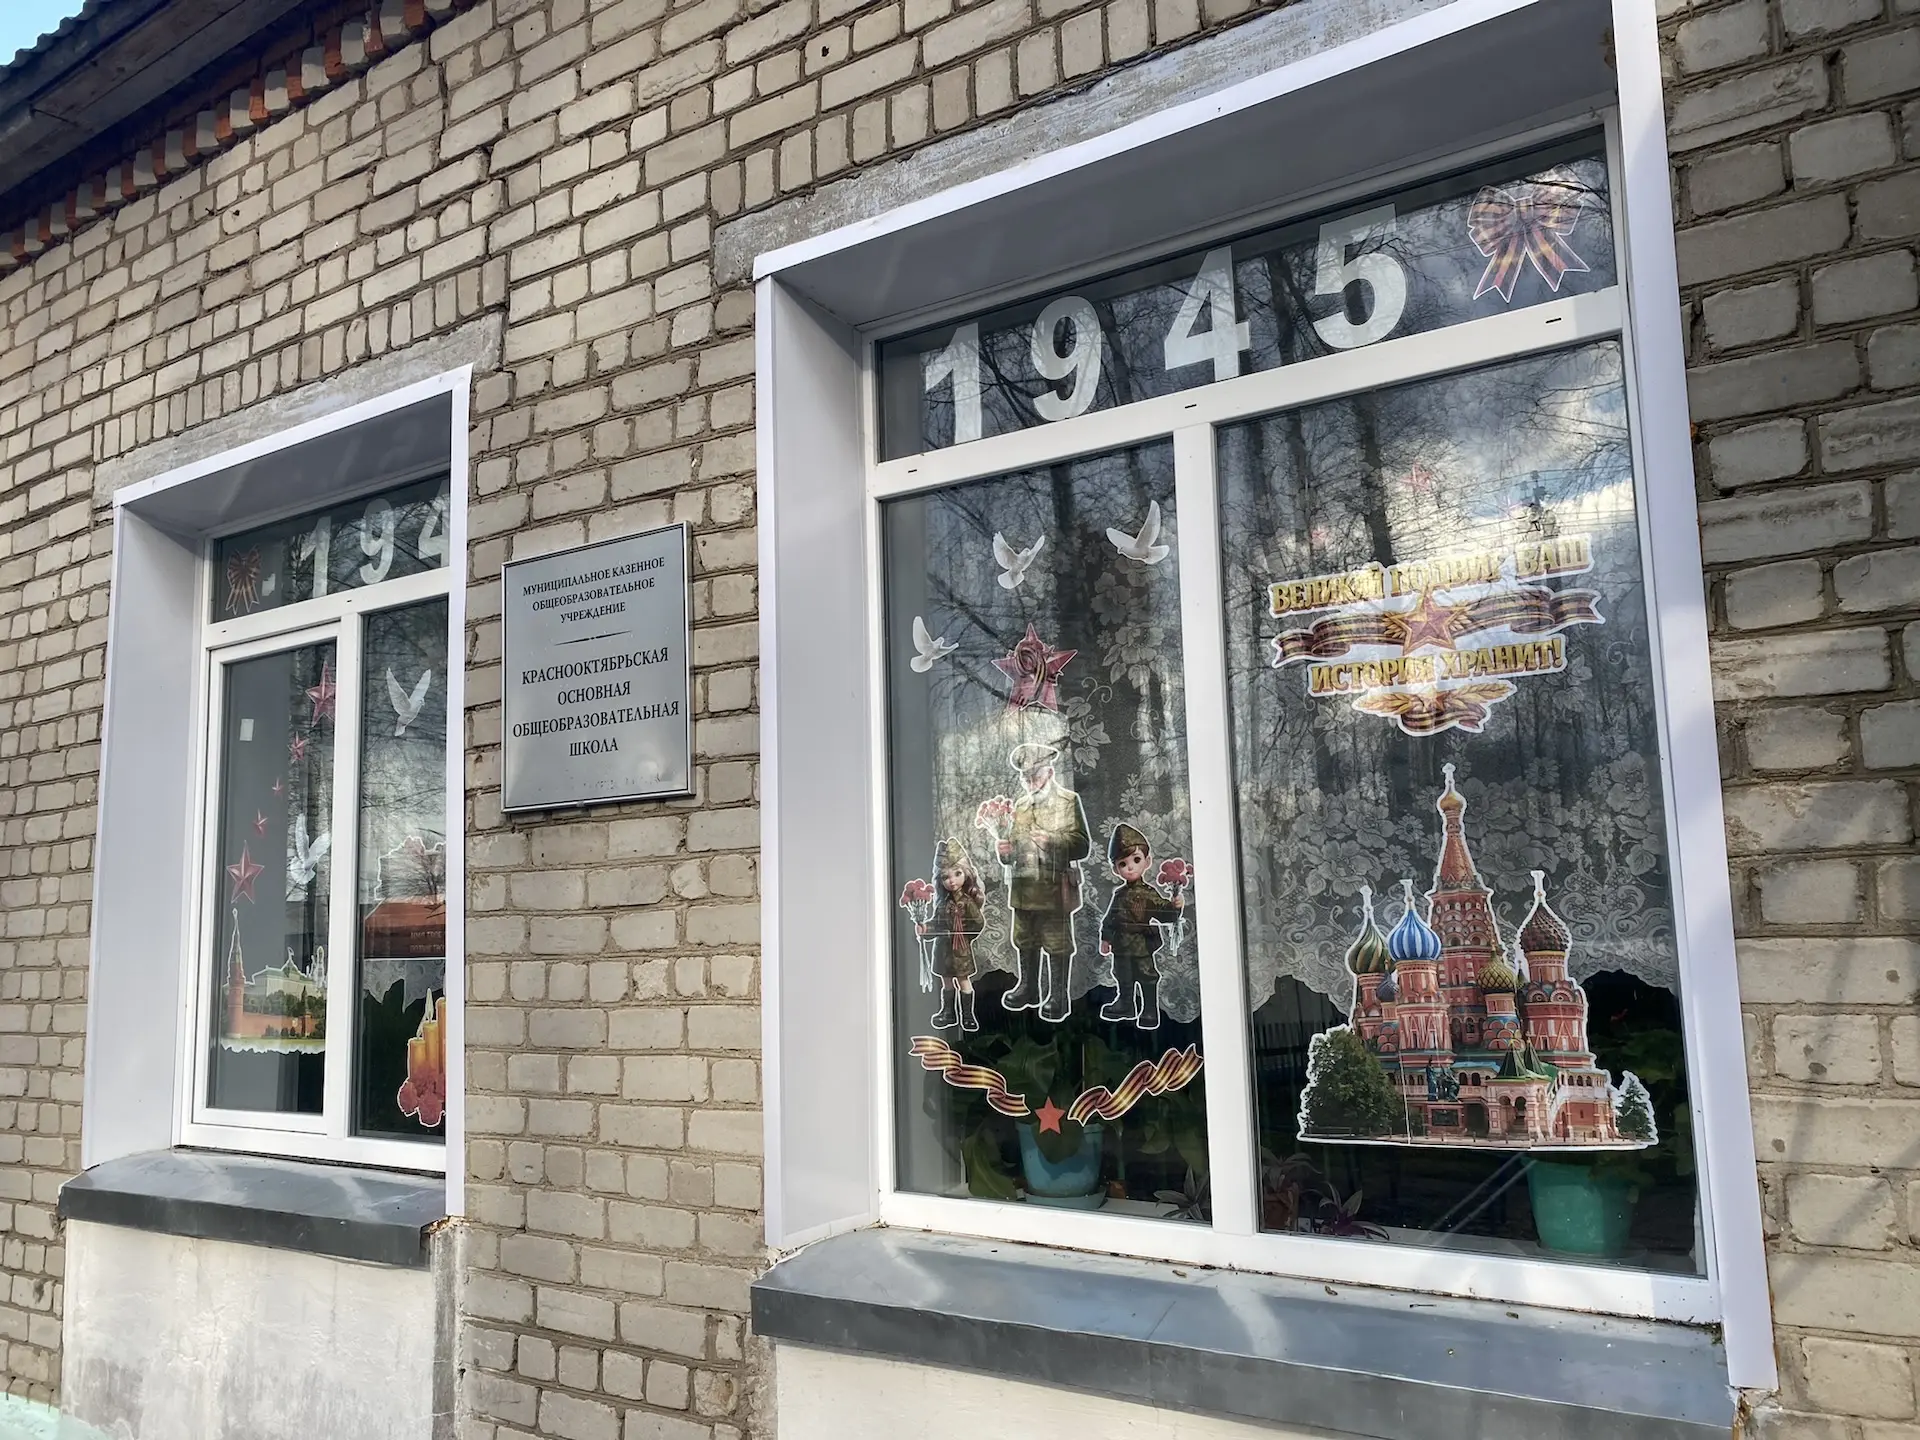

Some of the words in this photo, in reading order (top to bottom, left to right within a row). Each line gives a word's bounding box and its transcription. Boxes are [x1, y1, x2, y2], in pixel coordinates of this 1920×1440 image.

[923, 203, 1407, 444] 1945
[523, 569, 611, 596] МУНИЦИПАЛЬНОЕ
[612, 557, 665, 577] КАЗЕННОЕ
[532, 577, 655, 611] ОБЩЕОБРАЗОВАТЕЛЬНОЕ
[1272, 567, 1385, 614] ВЕЛИКИЙ
[1516, 538, 1590, 578] ВАШ
[560, 602, 626, 623] УЧРЕЖДЕНИЕ
[522, 647, 669, 684] КРАСНООКТЯБРЬСКАЯ
[1311, 655, 1436, 693] ИСТОРИЯ
[1440, 638, 1563, 679] ХРАНИТ!
[557, 681, 631, 705] ОСНОВНАЯ
[513, 701, 680, 737] ОБЩЕОБРАЗОВАТЕЛЬНАЯ
[569, 737, 619, 756] ШКОЛА
